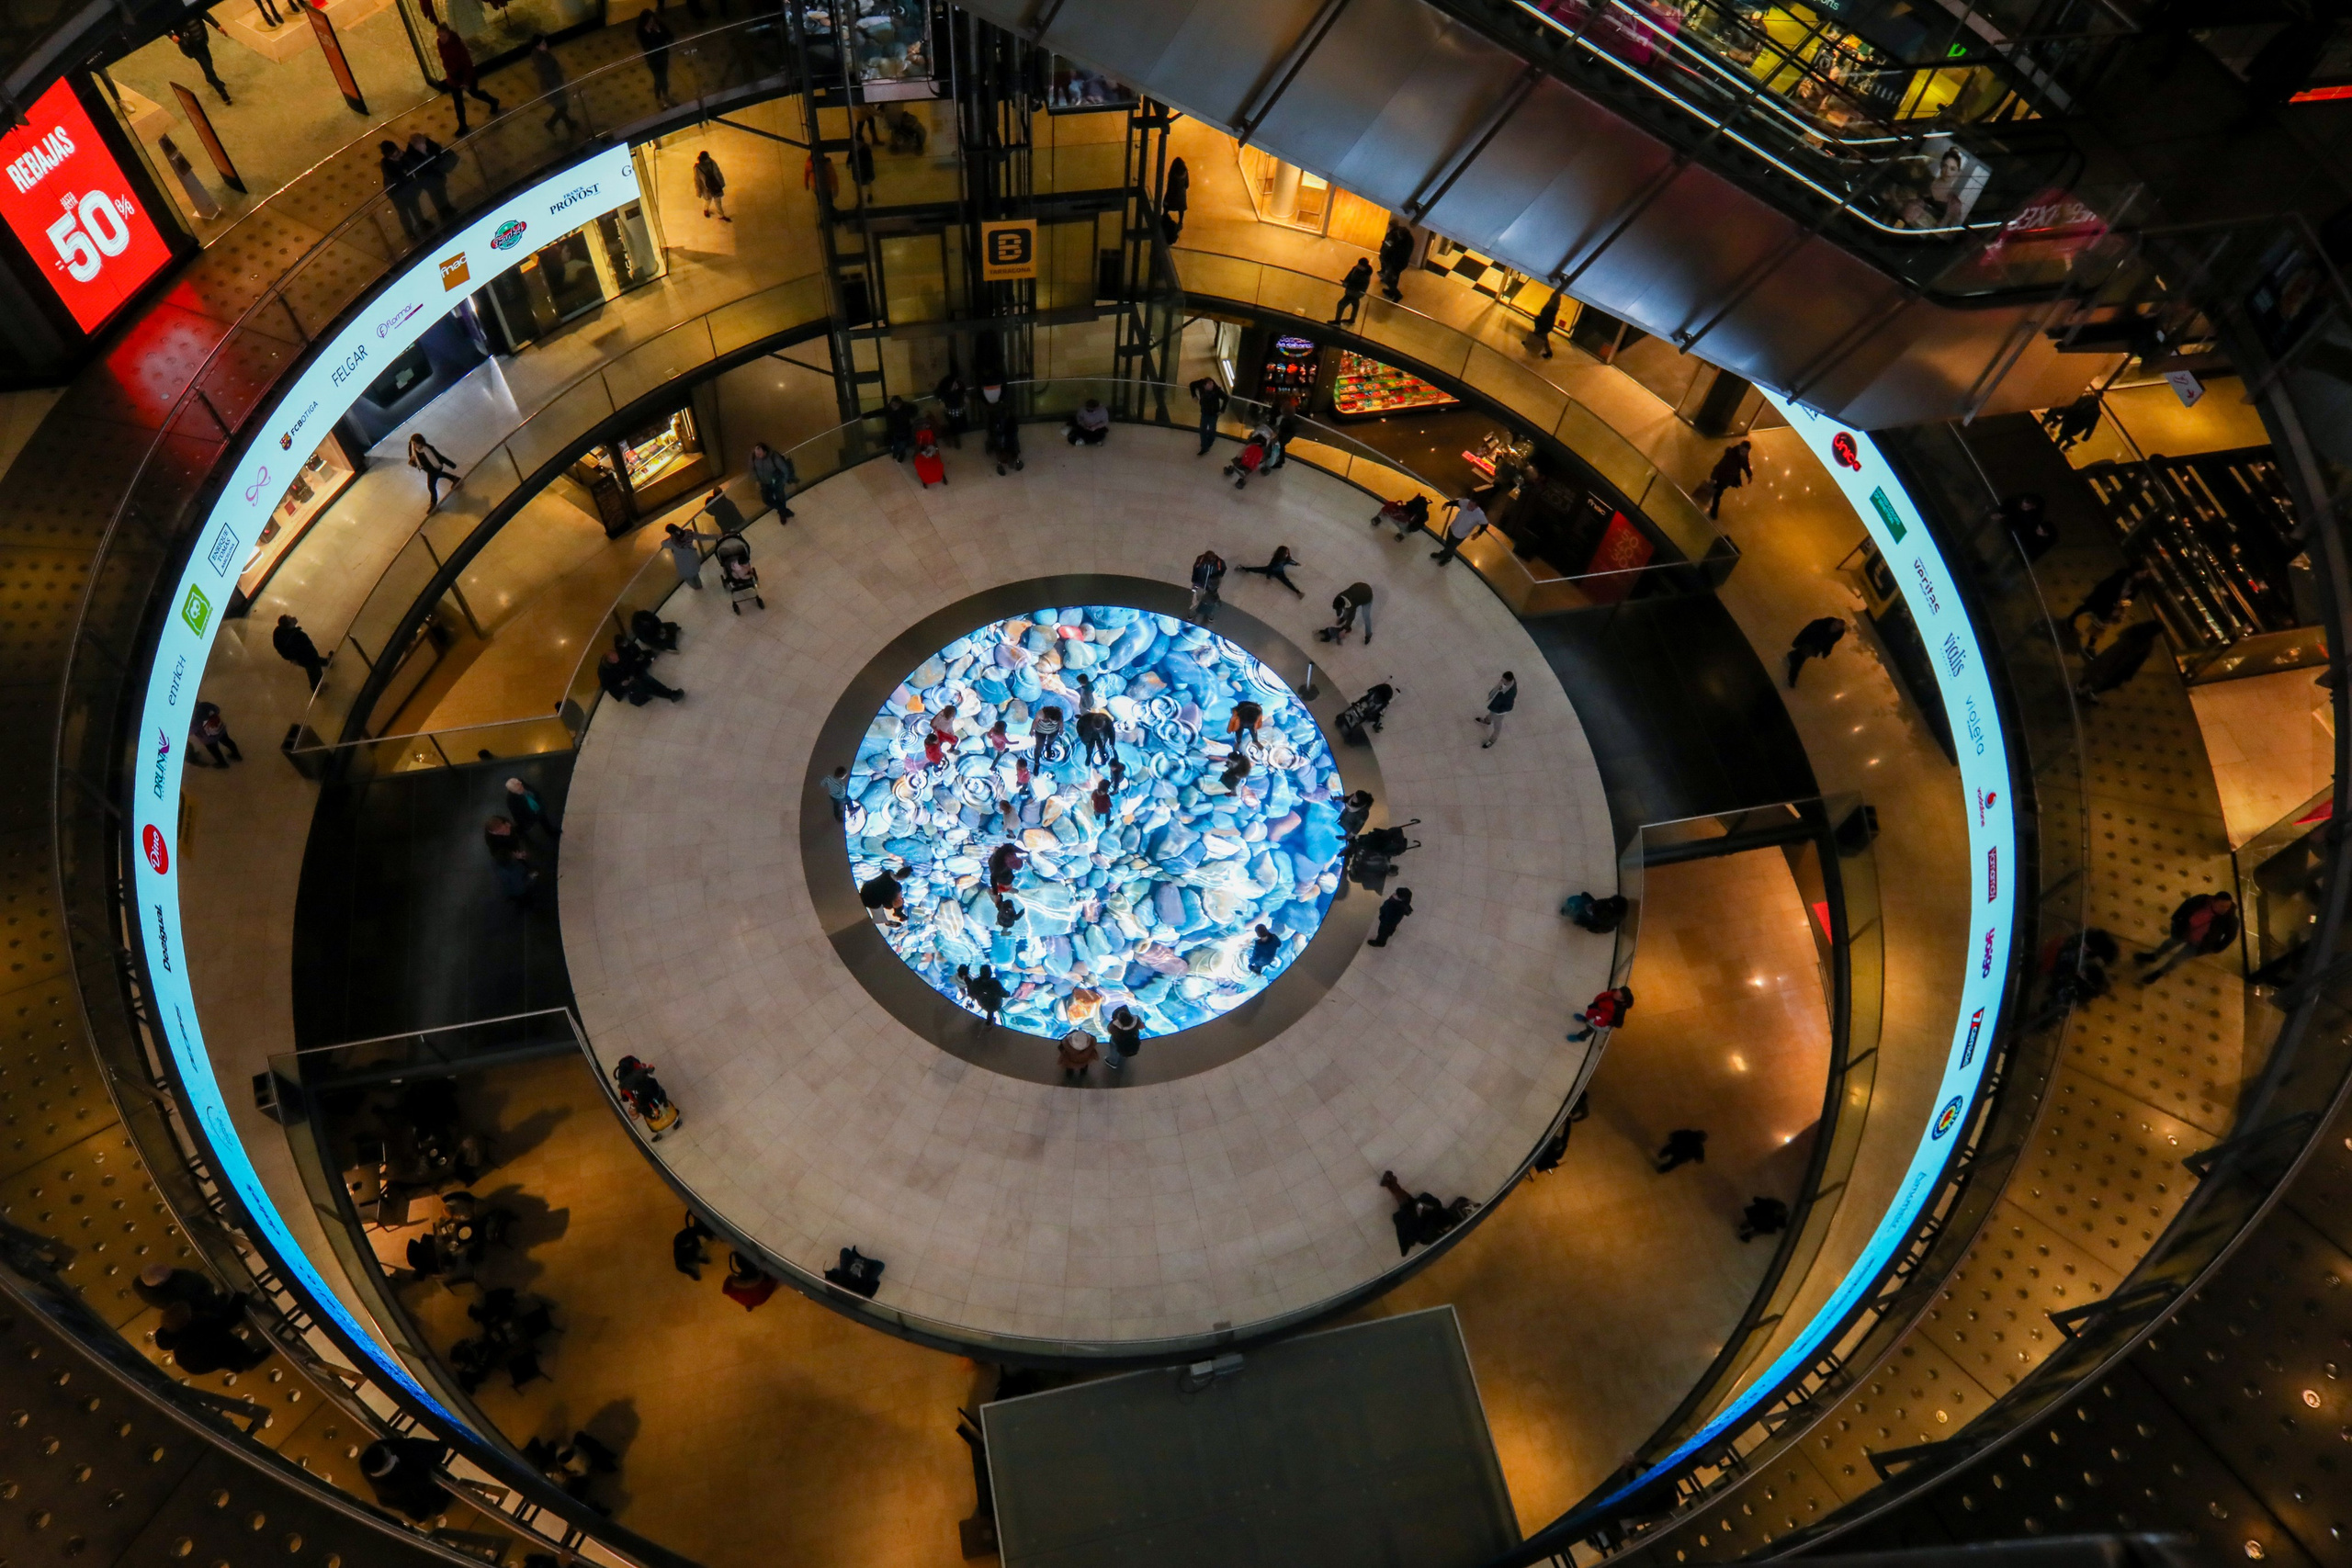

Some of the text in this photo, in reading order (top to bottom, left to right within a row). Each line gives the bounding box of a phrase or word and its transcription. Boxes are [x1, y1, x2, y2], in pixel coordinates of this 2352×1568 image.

[6, 125, 75, 194] REBAJAS
[549, 183, 600, 216] PROVOST
[440, 254, 468, 278] fnac
[331, 344, 368, 388] FELGAR
[1914, 559, 1940, 614] veritas
[1943, 632, 1966, 677] vialis
[1965, 694, 1984, 756] violeta
[1977, 786, 1985, 828] vodafone
[150, 830, 161, 868] Dino
[1982, 927, 1996, 979] yoigo
